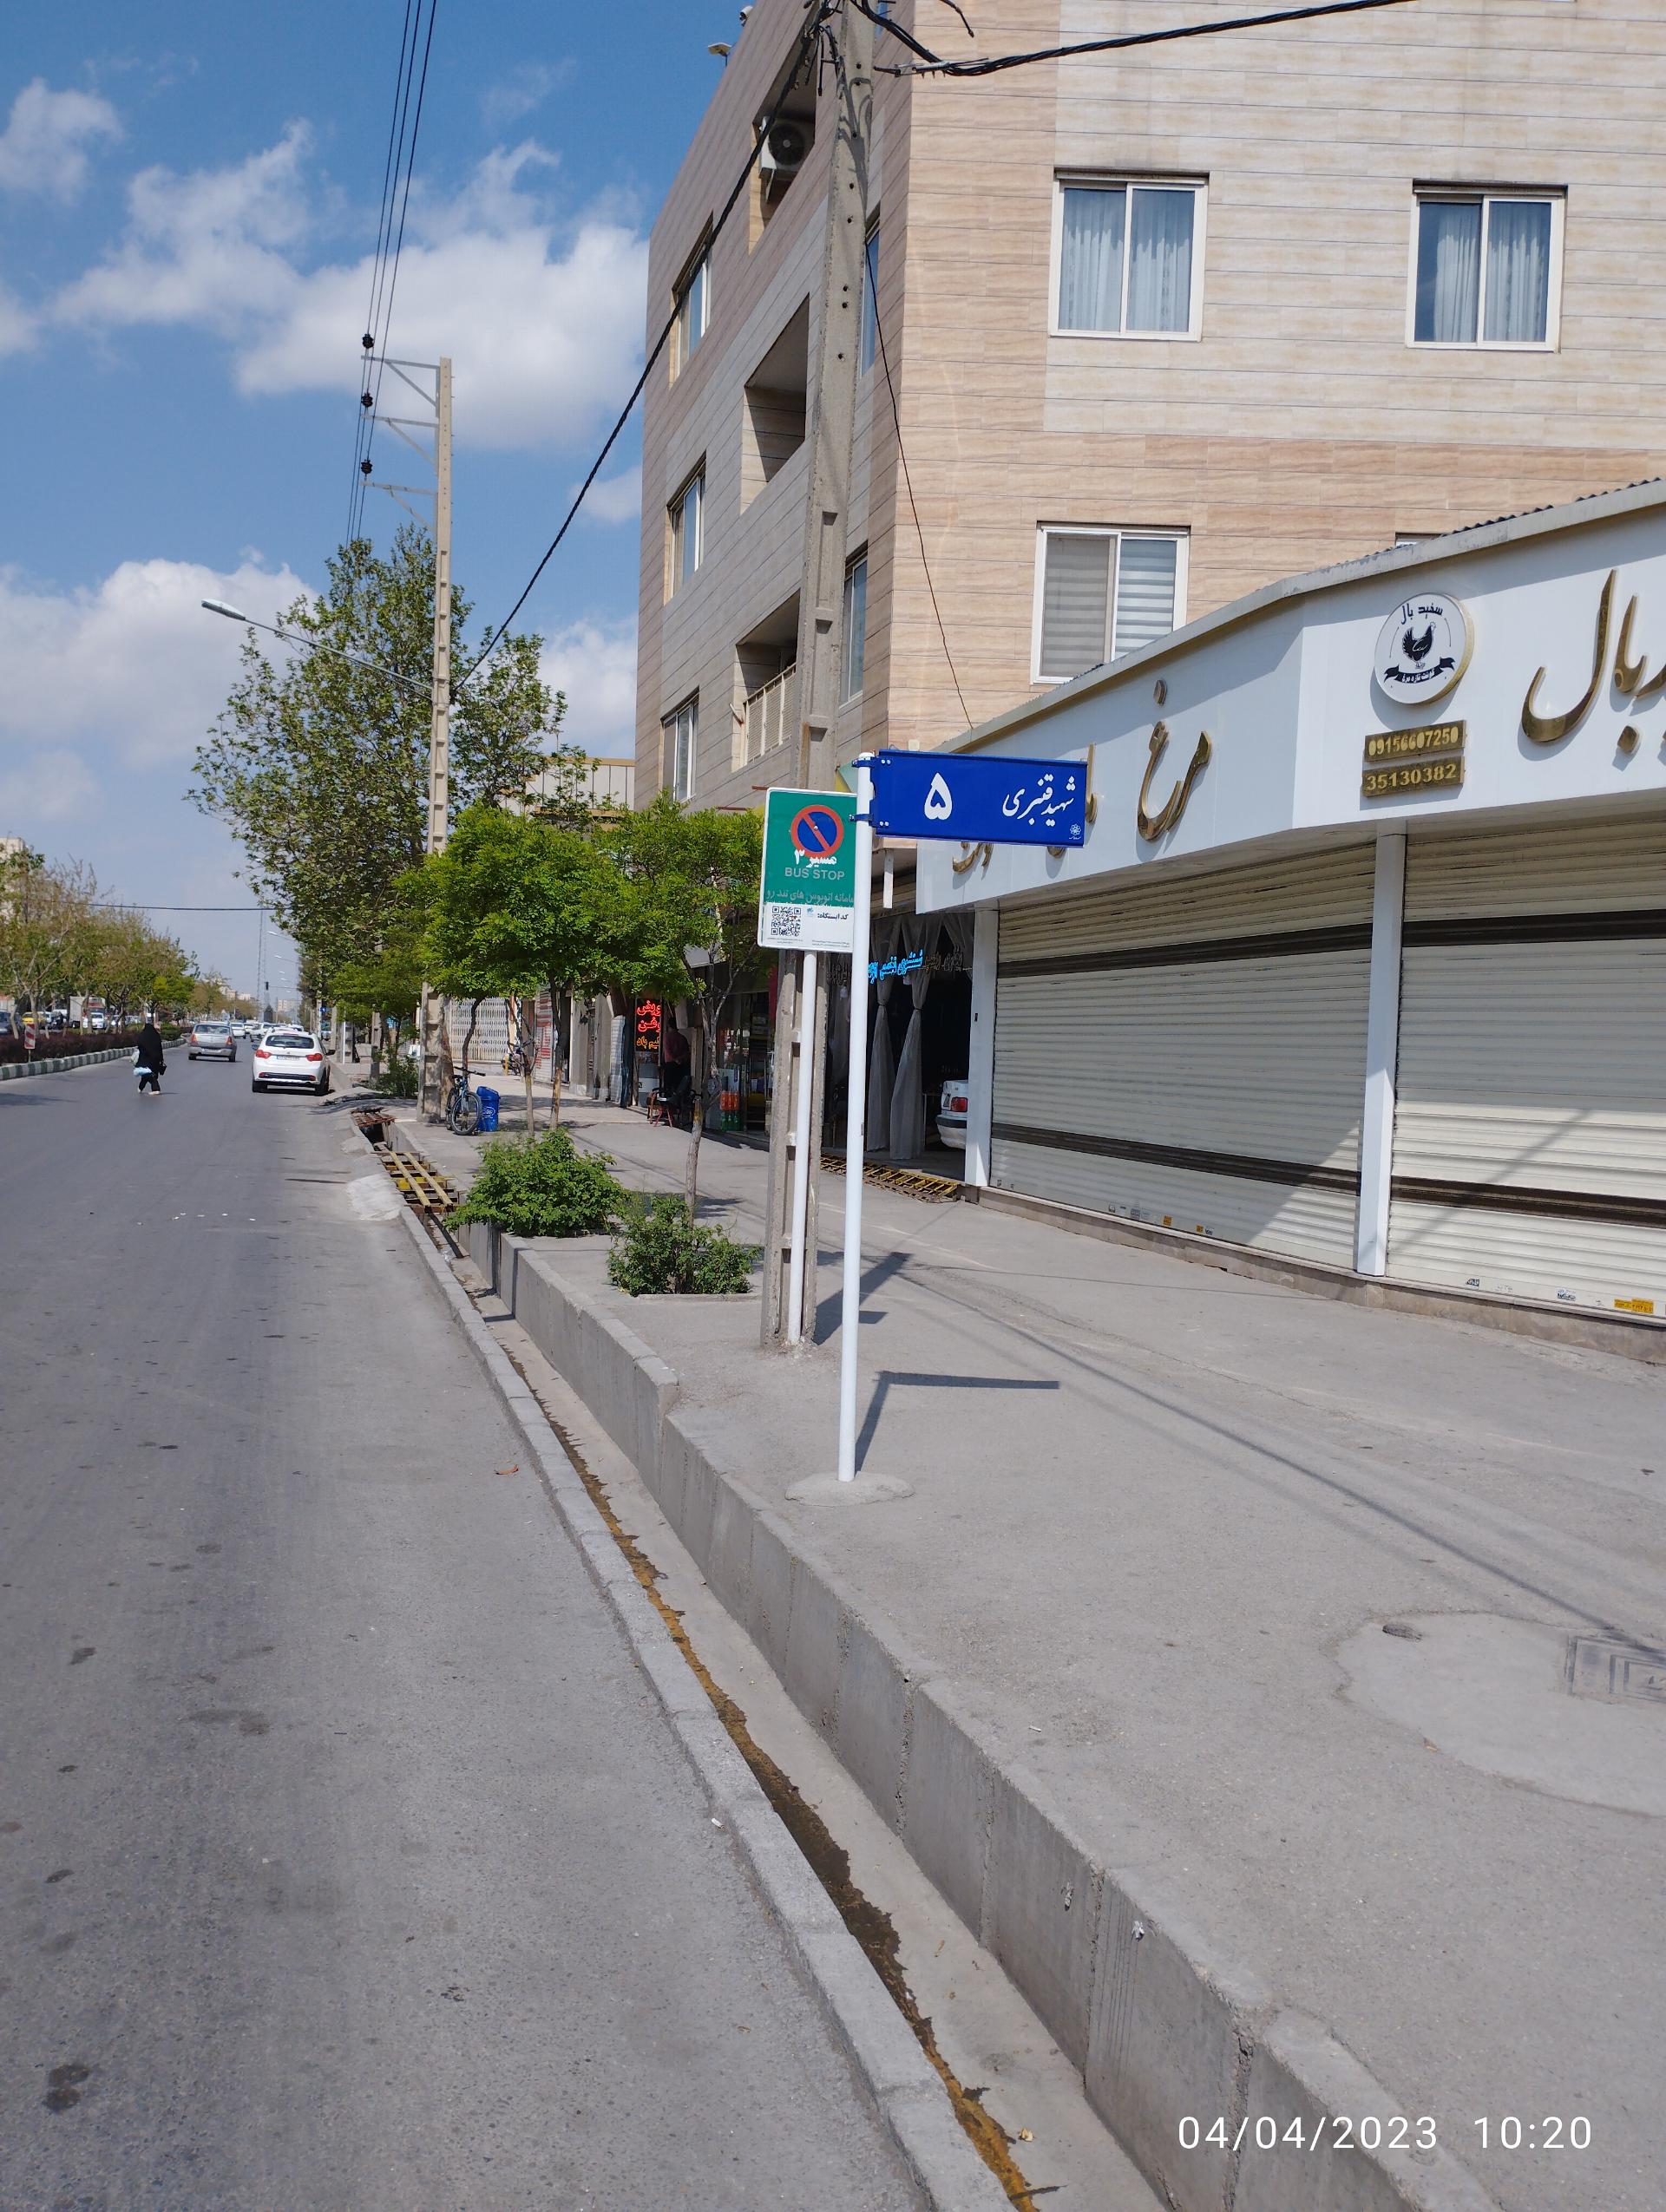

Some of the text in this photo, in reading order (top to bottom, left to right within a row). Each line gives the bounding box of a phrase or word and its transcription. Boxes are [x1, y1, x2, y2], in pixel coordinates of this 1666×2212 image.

[1401, 602, 1444, 625] سفید بال
[1368, 726, 1459, 756] 09156607250
[1367, 763, 1458, 790] 35130382
[923, 772, 953, 821] ۵
[1002, 773, 1054, 826] قنبری
[1041, 776, 1076, 827] شهید
[784, 867, 845, 880] BUS STOP
[766, 890, 775, 900] رو
[777, 889, 789, 898] تند
[790, 889, 804, 900] های
[806, 892, 833, 903] اتوبوس
